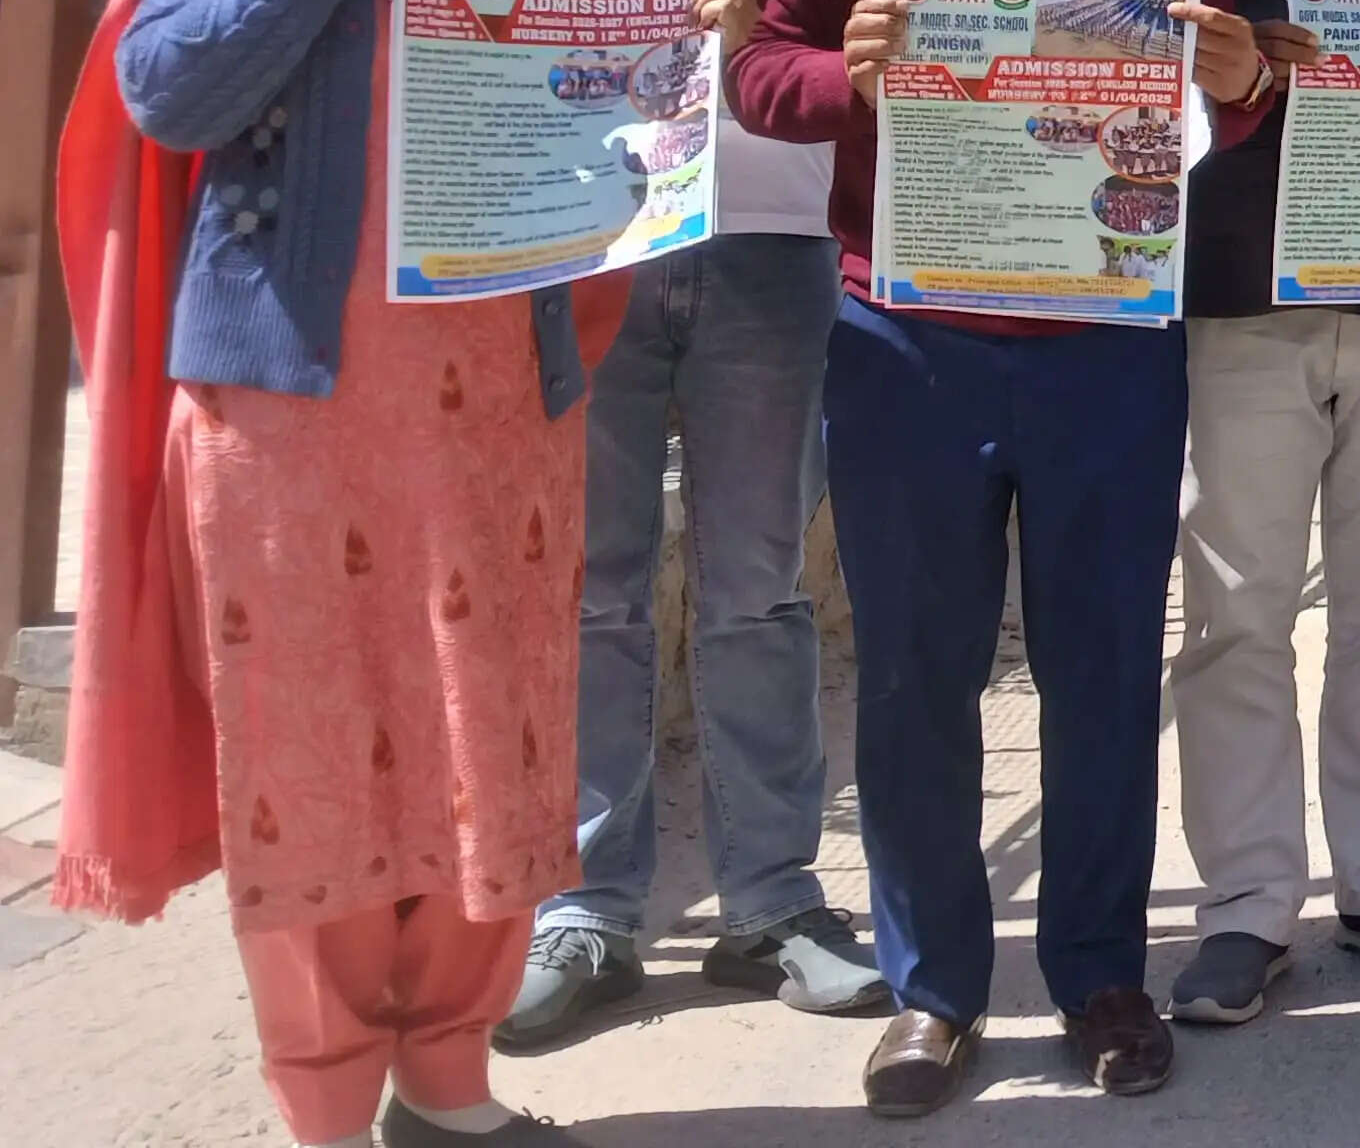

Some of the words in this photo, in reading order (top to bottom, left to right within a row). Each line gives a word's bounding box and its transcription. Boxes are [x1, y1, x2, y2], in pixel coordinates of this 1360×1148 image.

[993, 16, 1028, 32] SCHOOL
[577, 30, 596, 42] TO
[917, 36, 982, 52] PANGNA
[997, 60, 1116, 77] ADMISSION
[1122, 63, 1177, 80] OPEN
